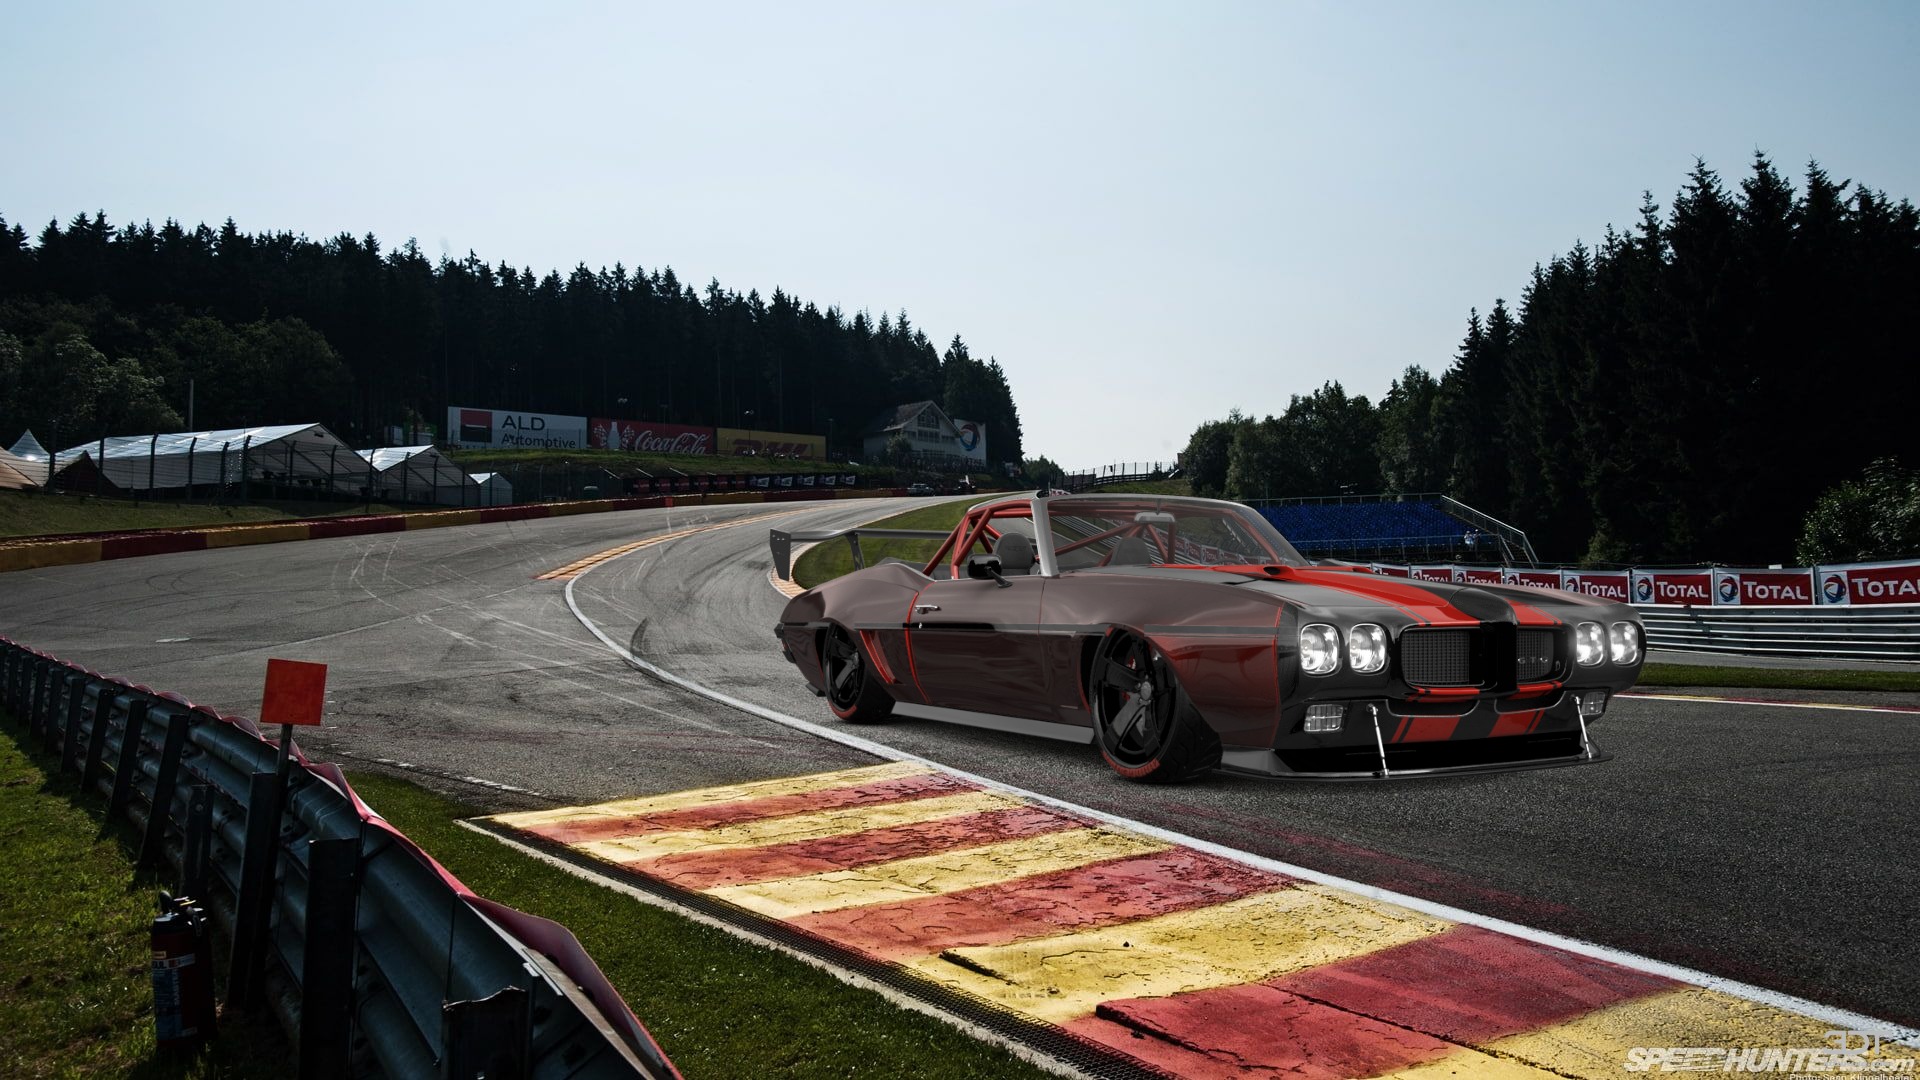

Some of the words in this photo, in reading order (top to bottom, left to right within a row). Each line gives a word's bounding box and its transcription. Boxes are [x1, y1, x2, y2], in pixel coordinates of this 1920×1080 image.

[502, 415, 545, 431] ALD
[501, 433, 576, 449] Automotive
[1583, 581, 1627, 598] TOTAL
[1656, 581, 1709, 598] TOTAL
[1743, 581, 1808, 600] TOTAL
